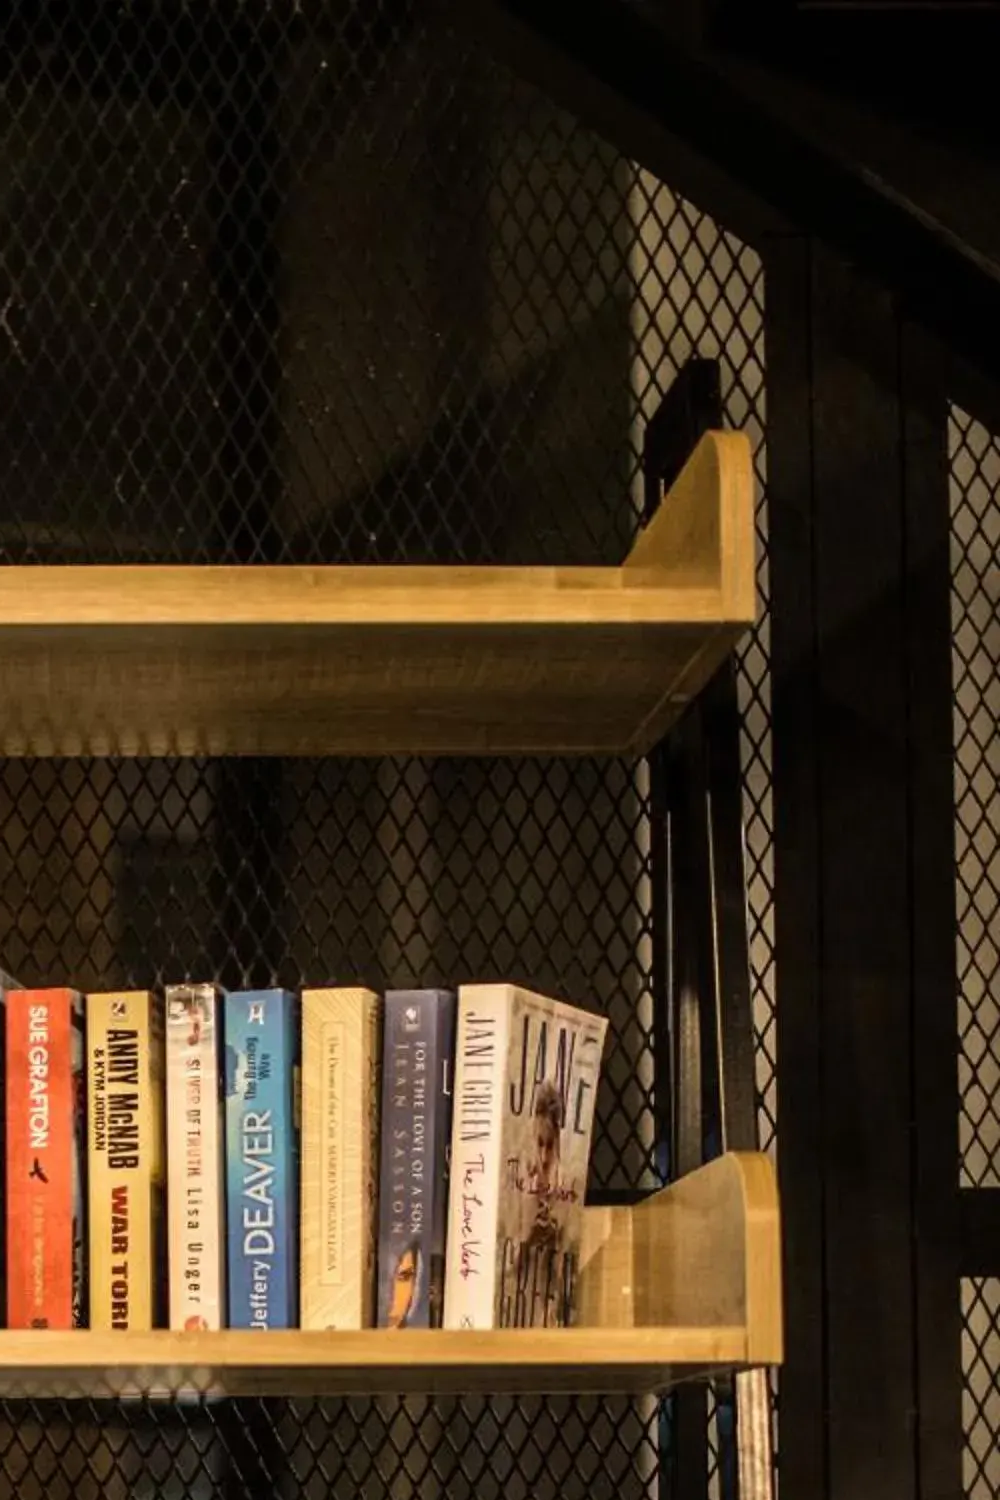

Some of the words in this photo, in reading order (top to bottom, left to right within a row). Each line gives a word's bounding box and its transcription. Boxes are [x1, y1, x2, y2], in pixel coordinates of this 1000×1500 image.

[29, 1005, 48, 1043] SUE
[462, 1011, 496, 1071] JANE
[94, 1061, 106, 1091] KYM
[95, 1048, 105, 1058] &
[106, 1029, 139, 1085] ANDY
[244, 1036, 259, 1082] Burning
[394, 1042, 409, 1108] JEAN
[414, 1041, 427, 1071] FOR
[509, 1013, 592, 1136] JANE
[29, 1046, 48, 1148] GRAFTON
[184, 1059, 201, 1106] SLIVER
[244, 1083, 258, 1101] The
[412, 1079, 426, 1108] THE
[94, 1094, 106, 1151] JORDAN
[106, 1093, 139, 1169] McNAB
[187, 1109, 201, 1125] OF
[459, 1078, 493, 1142] GREEN
[185, 1129, 201, 1177] TRUTH
[412, 1115, 425, 1154] LOVE
[243, 1108, 275, 1256] DEAVER
[392, 1130, 407, 1234] SASSON
[411, 1159, 425, 1181] OF
[411, 1187, 424, 1198] A
[464, 1154, 486, 1185] The
[111, 1185, 128, 1255] WAR
[187, 1188, 203, 1230] Lisa
[410, 1203, 423, 1234] SON
[460, 1192, 484, 1238] Love
[183, 1242, 203, 1305] Unger
[459, 1240, 480, 1281] Verb
[250, 1259, 271, 1331] Jeffery
